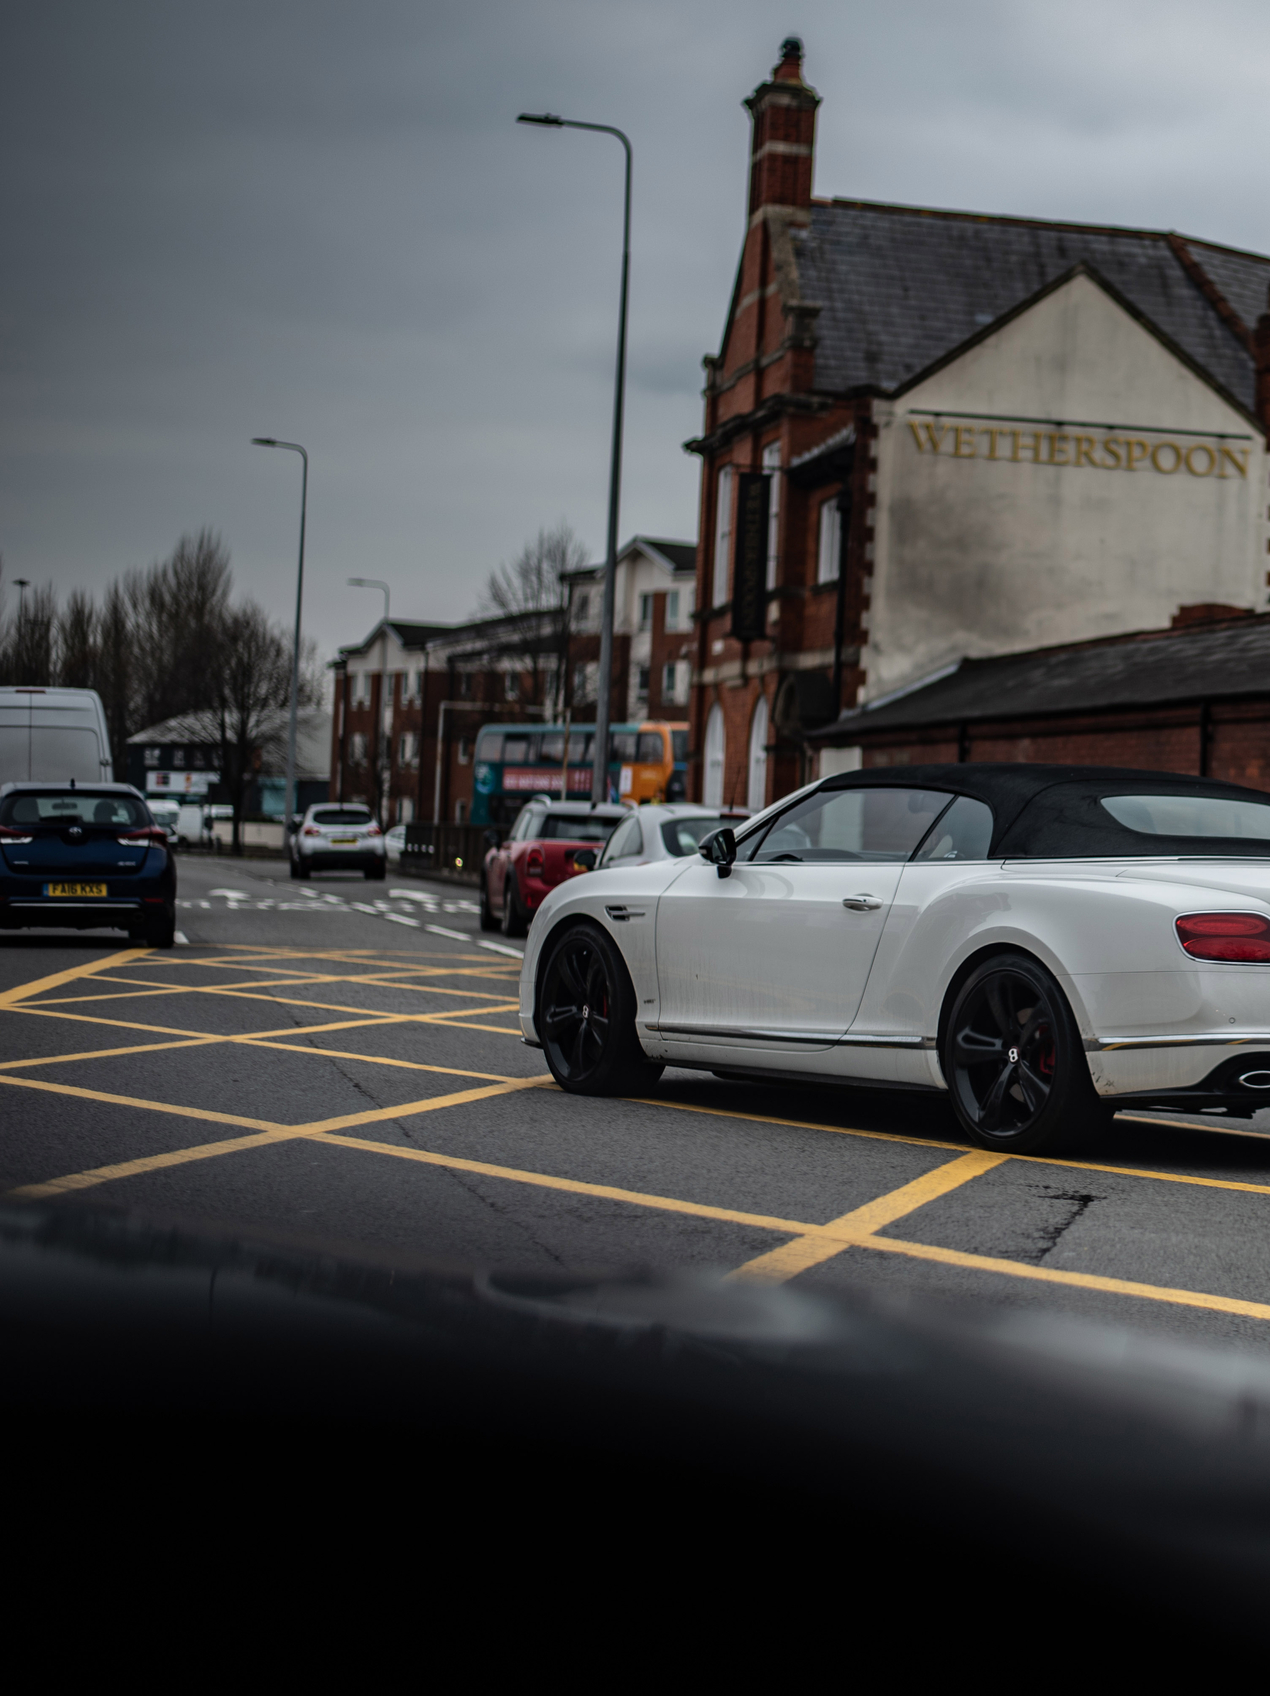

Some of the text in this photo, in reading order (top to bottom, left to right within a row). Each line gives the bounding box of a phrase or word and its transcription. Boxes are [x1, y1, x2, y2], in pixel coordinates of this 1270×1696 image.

[908, 420, 1251, 479] WETHERSPOON
[53, 883, 103, 895] FA16 KXS
